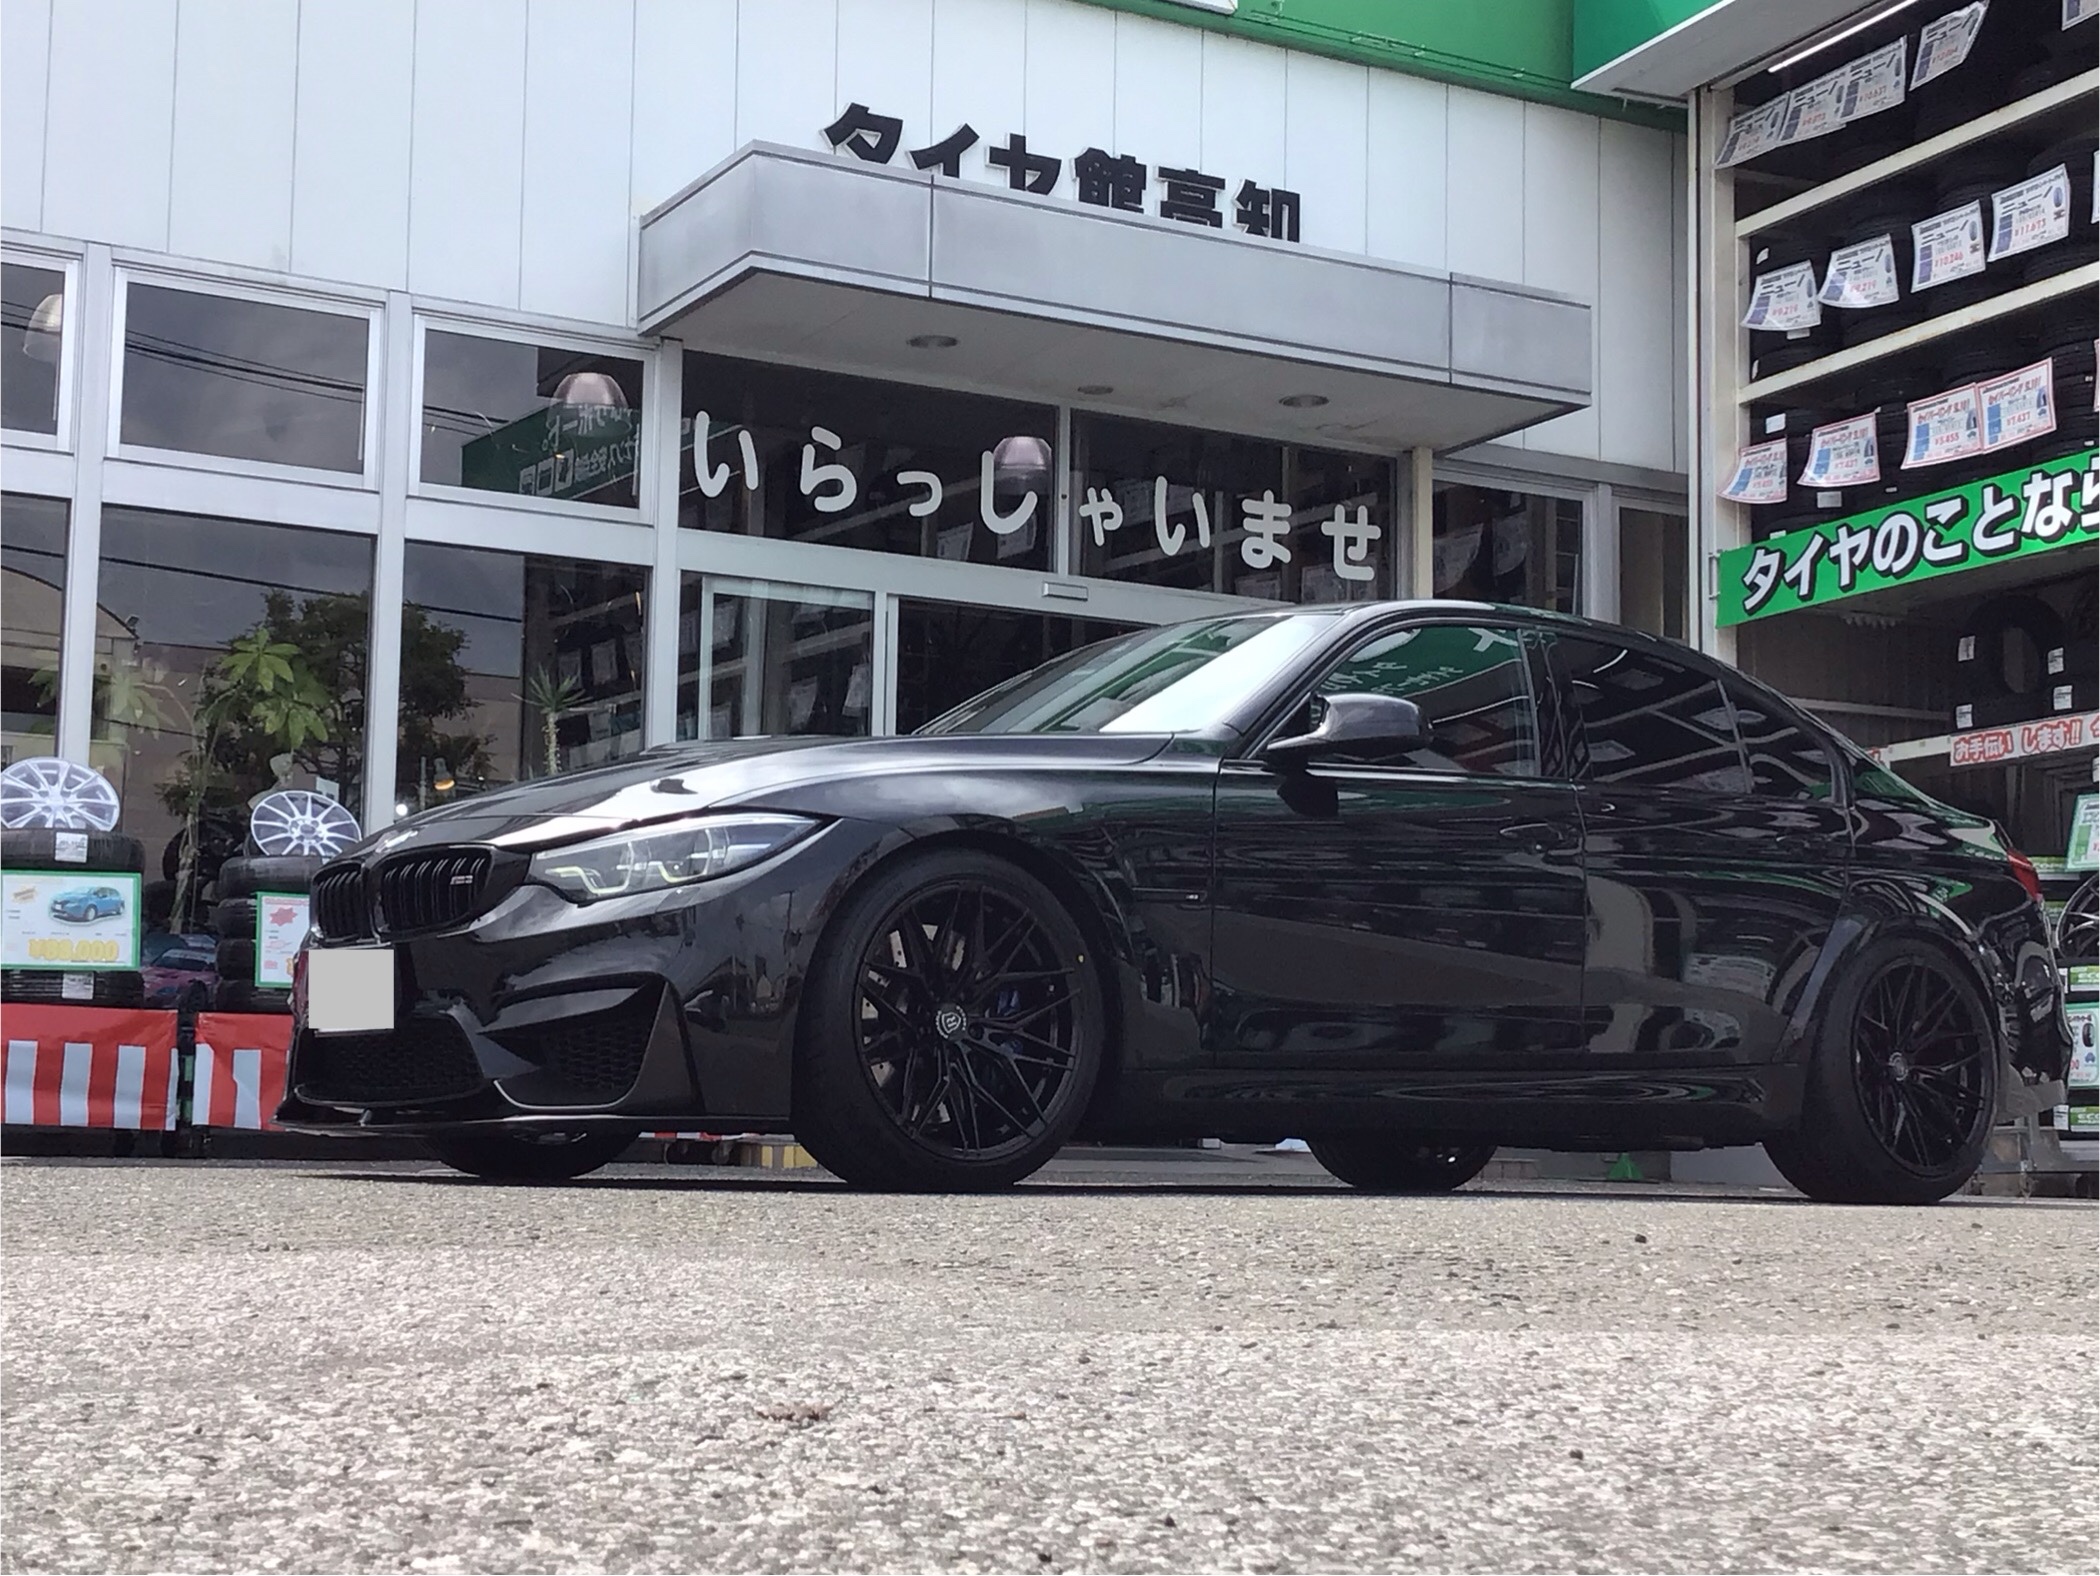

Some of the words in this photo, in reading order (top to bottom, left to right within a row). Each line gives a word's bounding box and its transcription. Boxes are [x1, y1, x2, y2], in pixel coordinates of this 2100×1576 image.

[822, 102, 1300, 242] タイヤ館高知
[693, 410, 1382, 581] いらっしゃいませ
[1954, 730, 2014, 763] お手伝い
